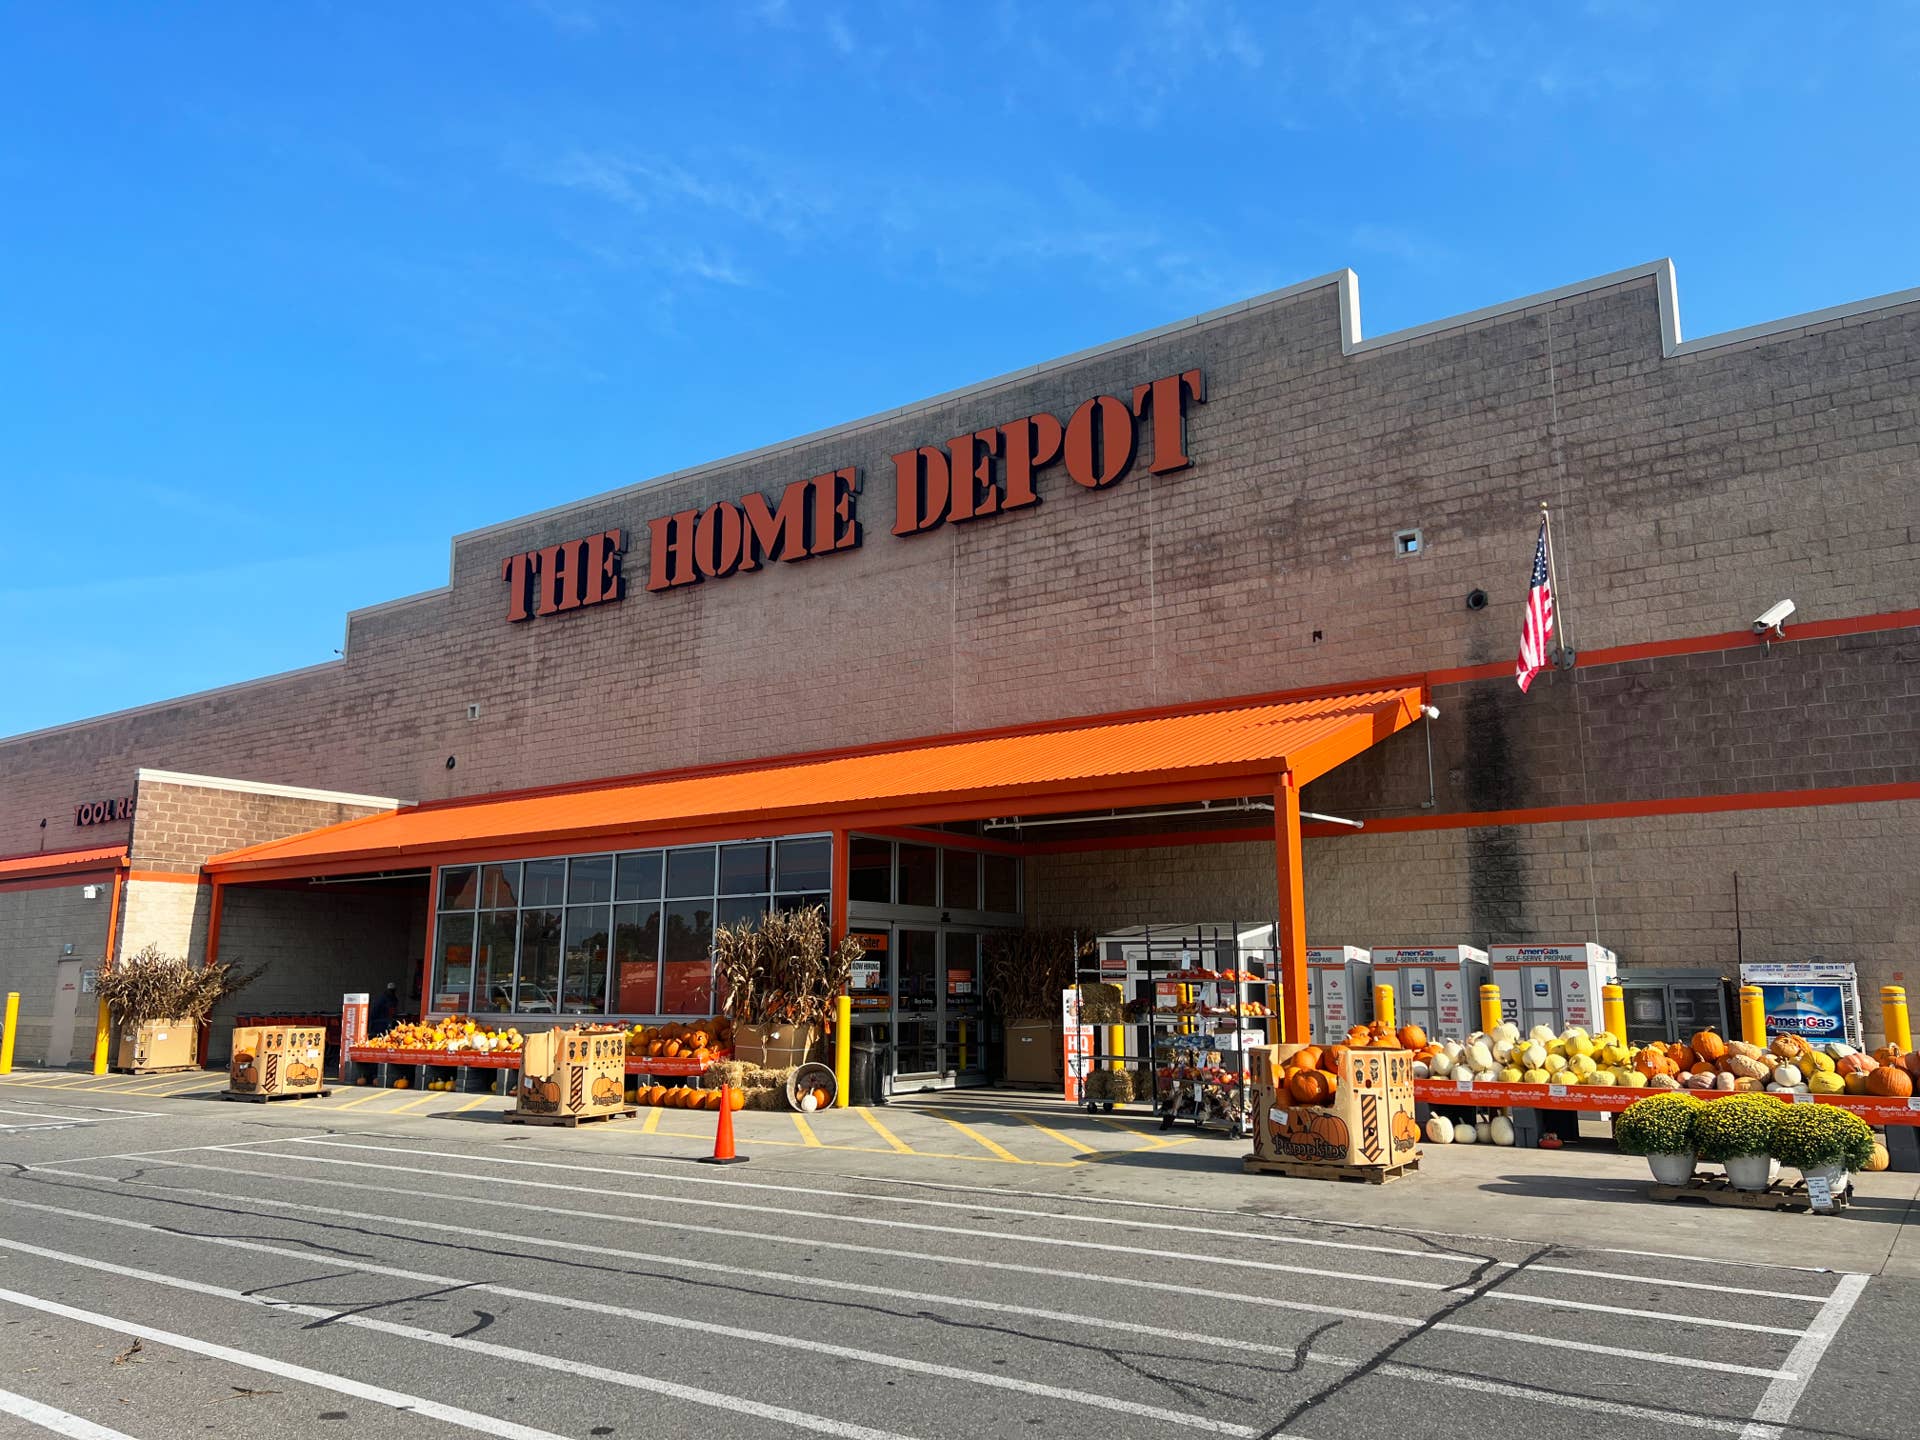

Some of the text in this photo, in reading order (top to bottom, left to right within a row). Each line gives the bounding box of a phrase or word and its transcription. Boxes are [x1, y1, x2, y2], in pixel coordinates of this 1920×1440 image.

[502, 368, 1207, 623] THE HOME DEPOT
[73, 800, 112, 826] TOOL
[1765, 1016, 1834, 1028] AmeriGas
[1271, 1133, 1347, 1159] Pumpkins
